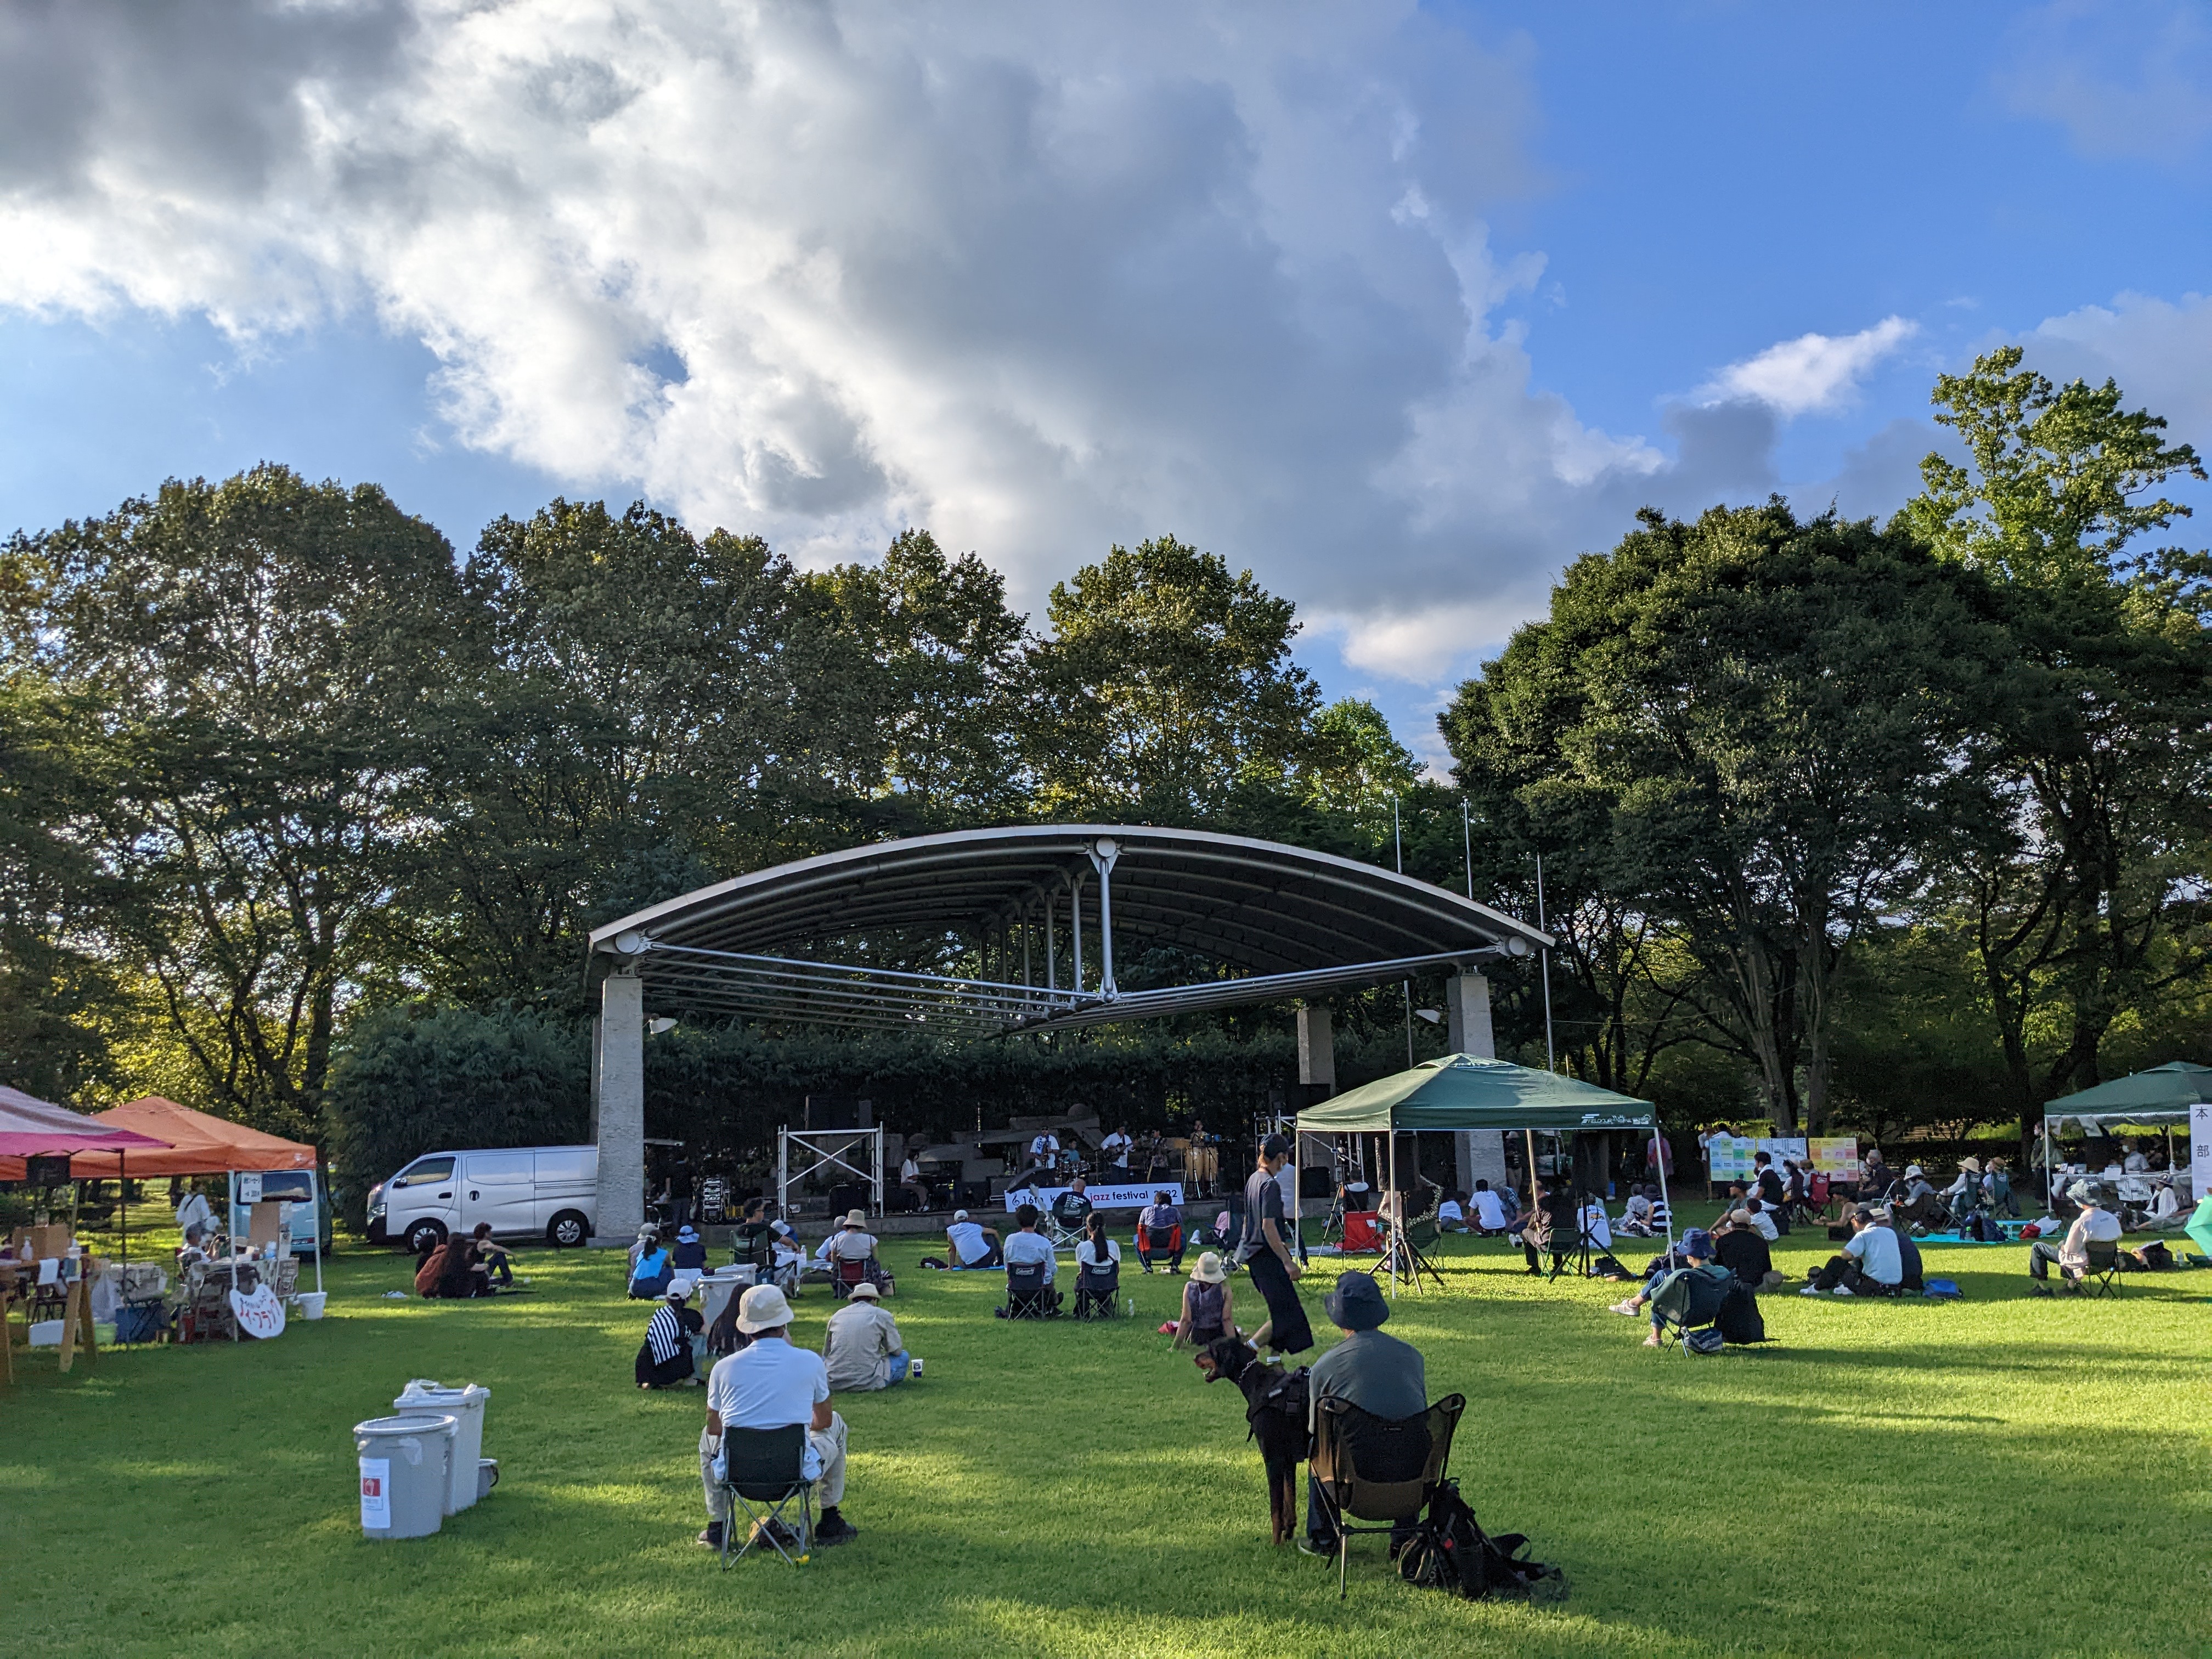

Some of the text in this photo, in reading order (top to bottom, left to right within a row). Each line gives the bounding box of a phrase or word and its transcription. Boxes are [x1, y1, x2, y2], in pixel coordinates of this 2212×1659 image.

[2196, 1106, 2209, 1158] 本部
[1090, 1193, 1110, 1203] jazz
[1112, 1190, 1148, 1200] festival
[1154, 1189, 1178, 1198] 22
